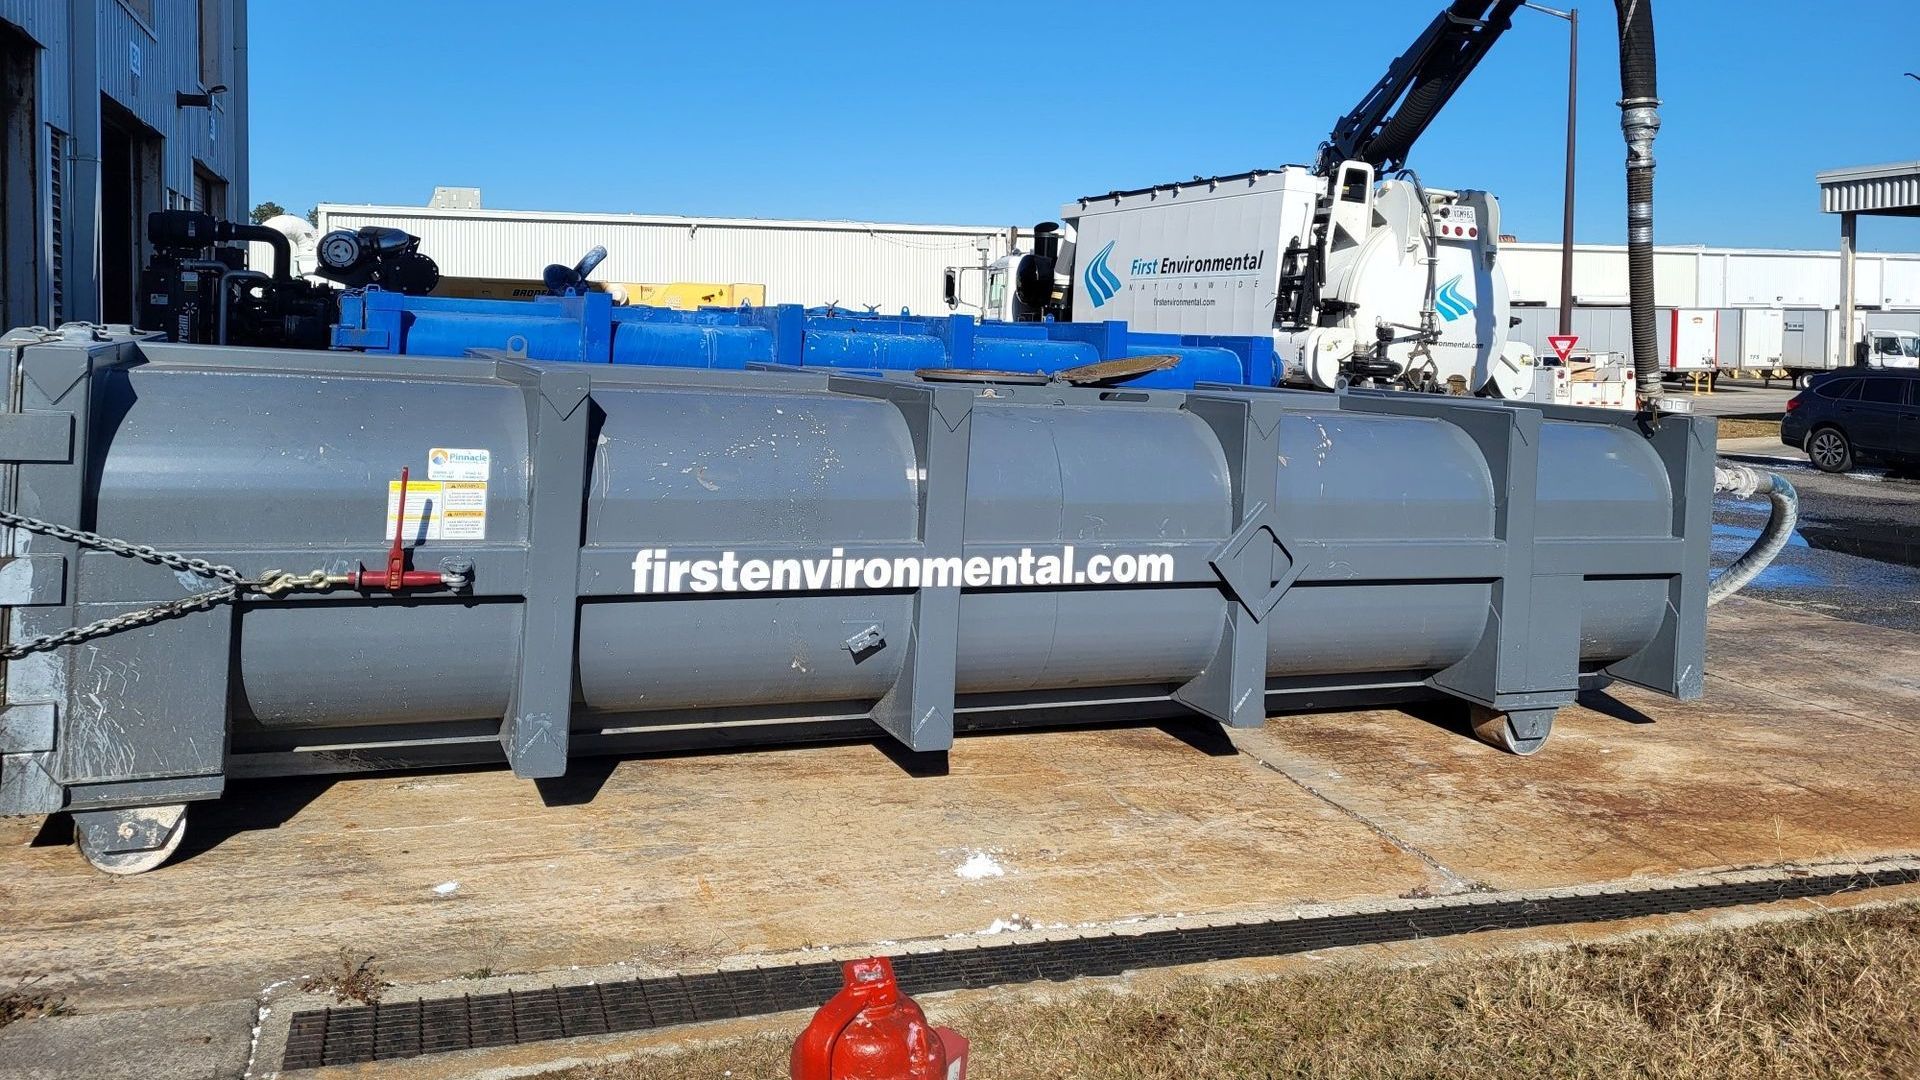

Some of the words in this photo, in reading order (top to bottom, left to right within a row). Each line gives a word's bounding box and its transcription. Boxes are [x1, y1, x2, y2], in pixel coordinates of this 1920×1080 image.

[1130, 258, 1158, 275] First
[1160, 249, 1264, 274] Environmental
[1153, 297, 1216, 307] firstenvironmental.com
[449, 452, 488, 462] Pinnacle
[631, 546, 1175, 594] firstenvironmental.com
